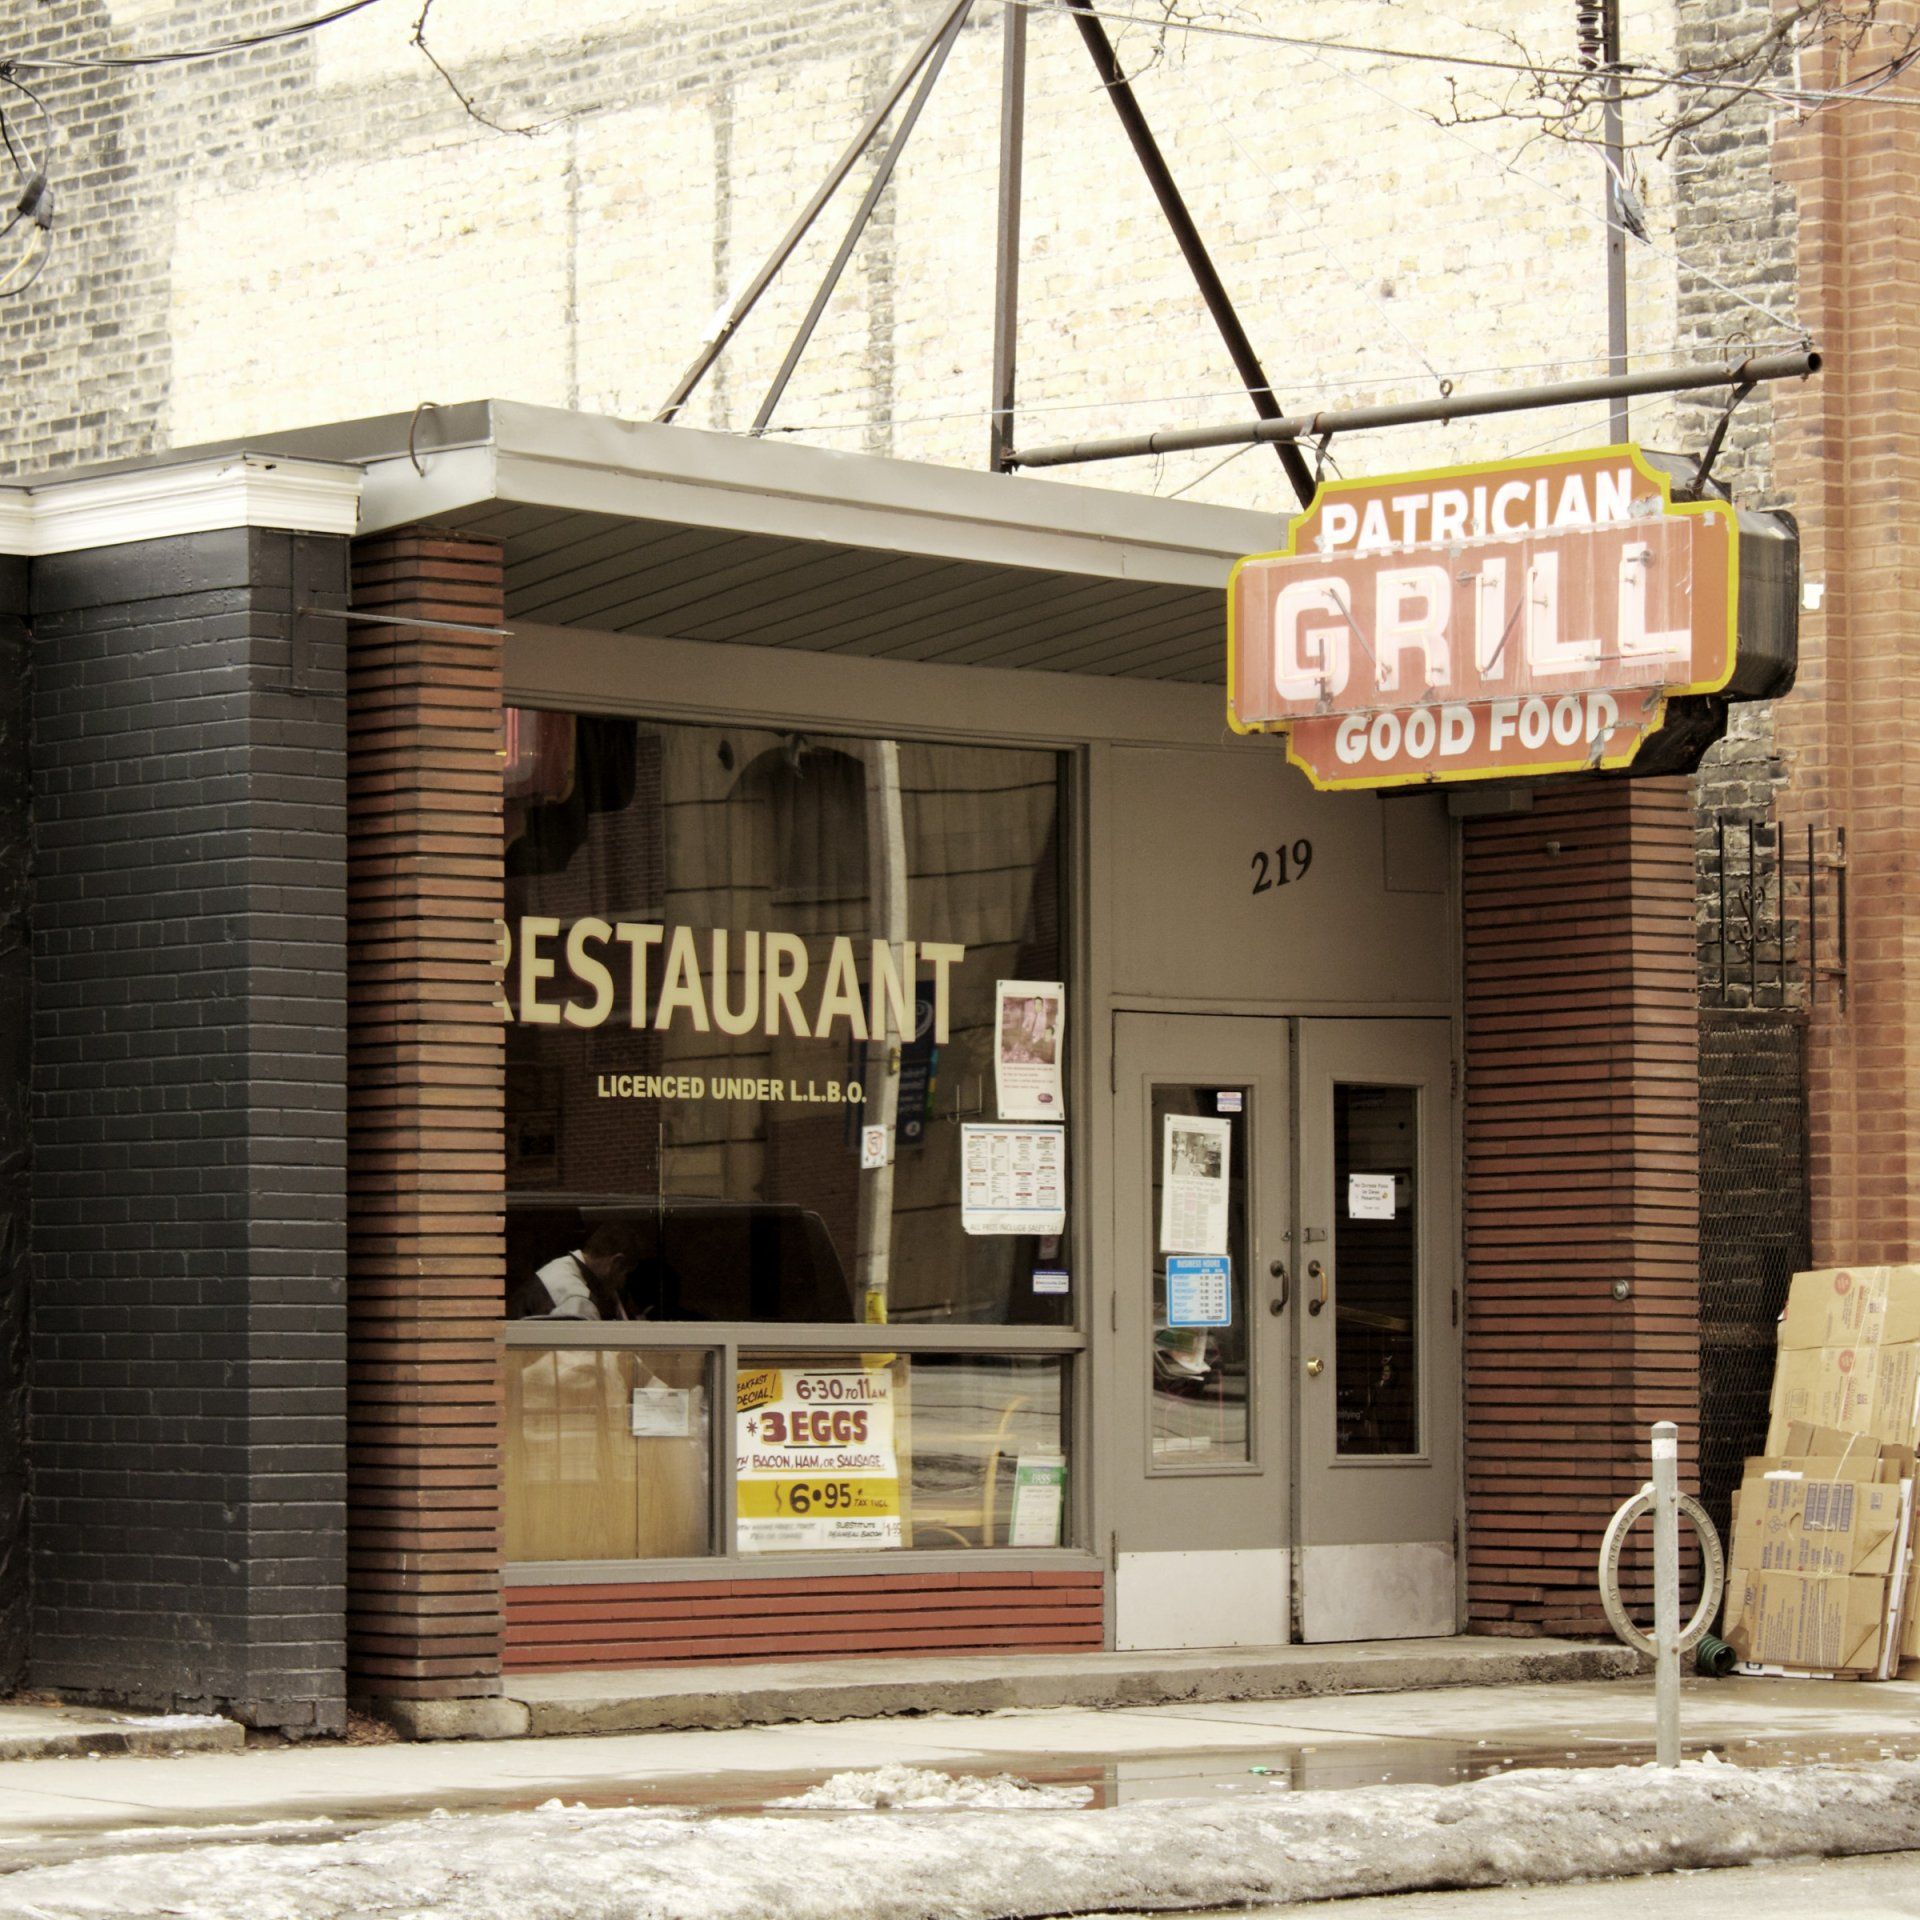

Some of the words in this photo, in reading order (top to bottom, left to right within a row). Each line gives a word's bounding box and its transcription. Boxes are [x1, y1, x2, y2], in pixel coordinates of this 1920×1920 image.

[1320, 468, 1632, 554] PATRICIAN
[1274, 541, 1691, 701] GRILL
[1335, 704, 1476, 764] GOOD
[1489, 692, 1619, 752] FOOD
[1251, 838, 1312, 895] 219
[598, 1075, 704, 1099] LICENCED
[711, 1077, 785, 1102] UNDER
[790, 1080, 867, 1103] L.L.B.O.
[761, 1411, 788, 1443] 3
[791, 1410, 868, 1443] EGGS
